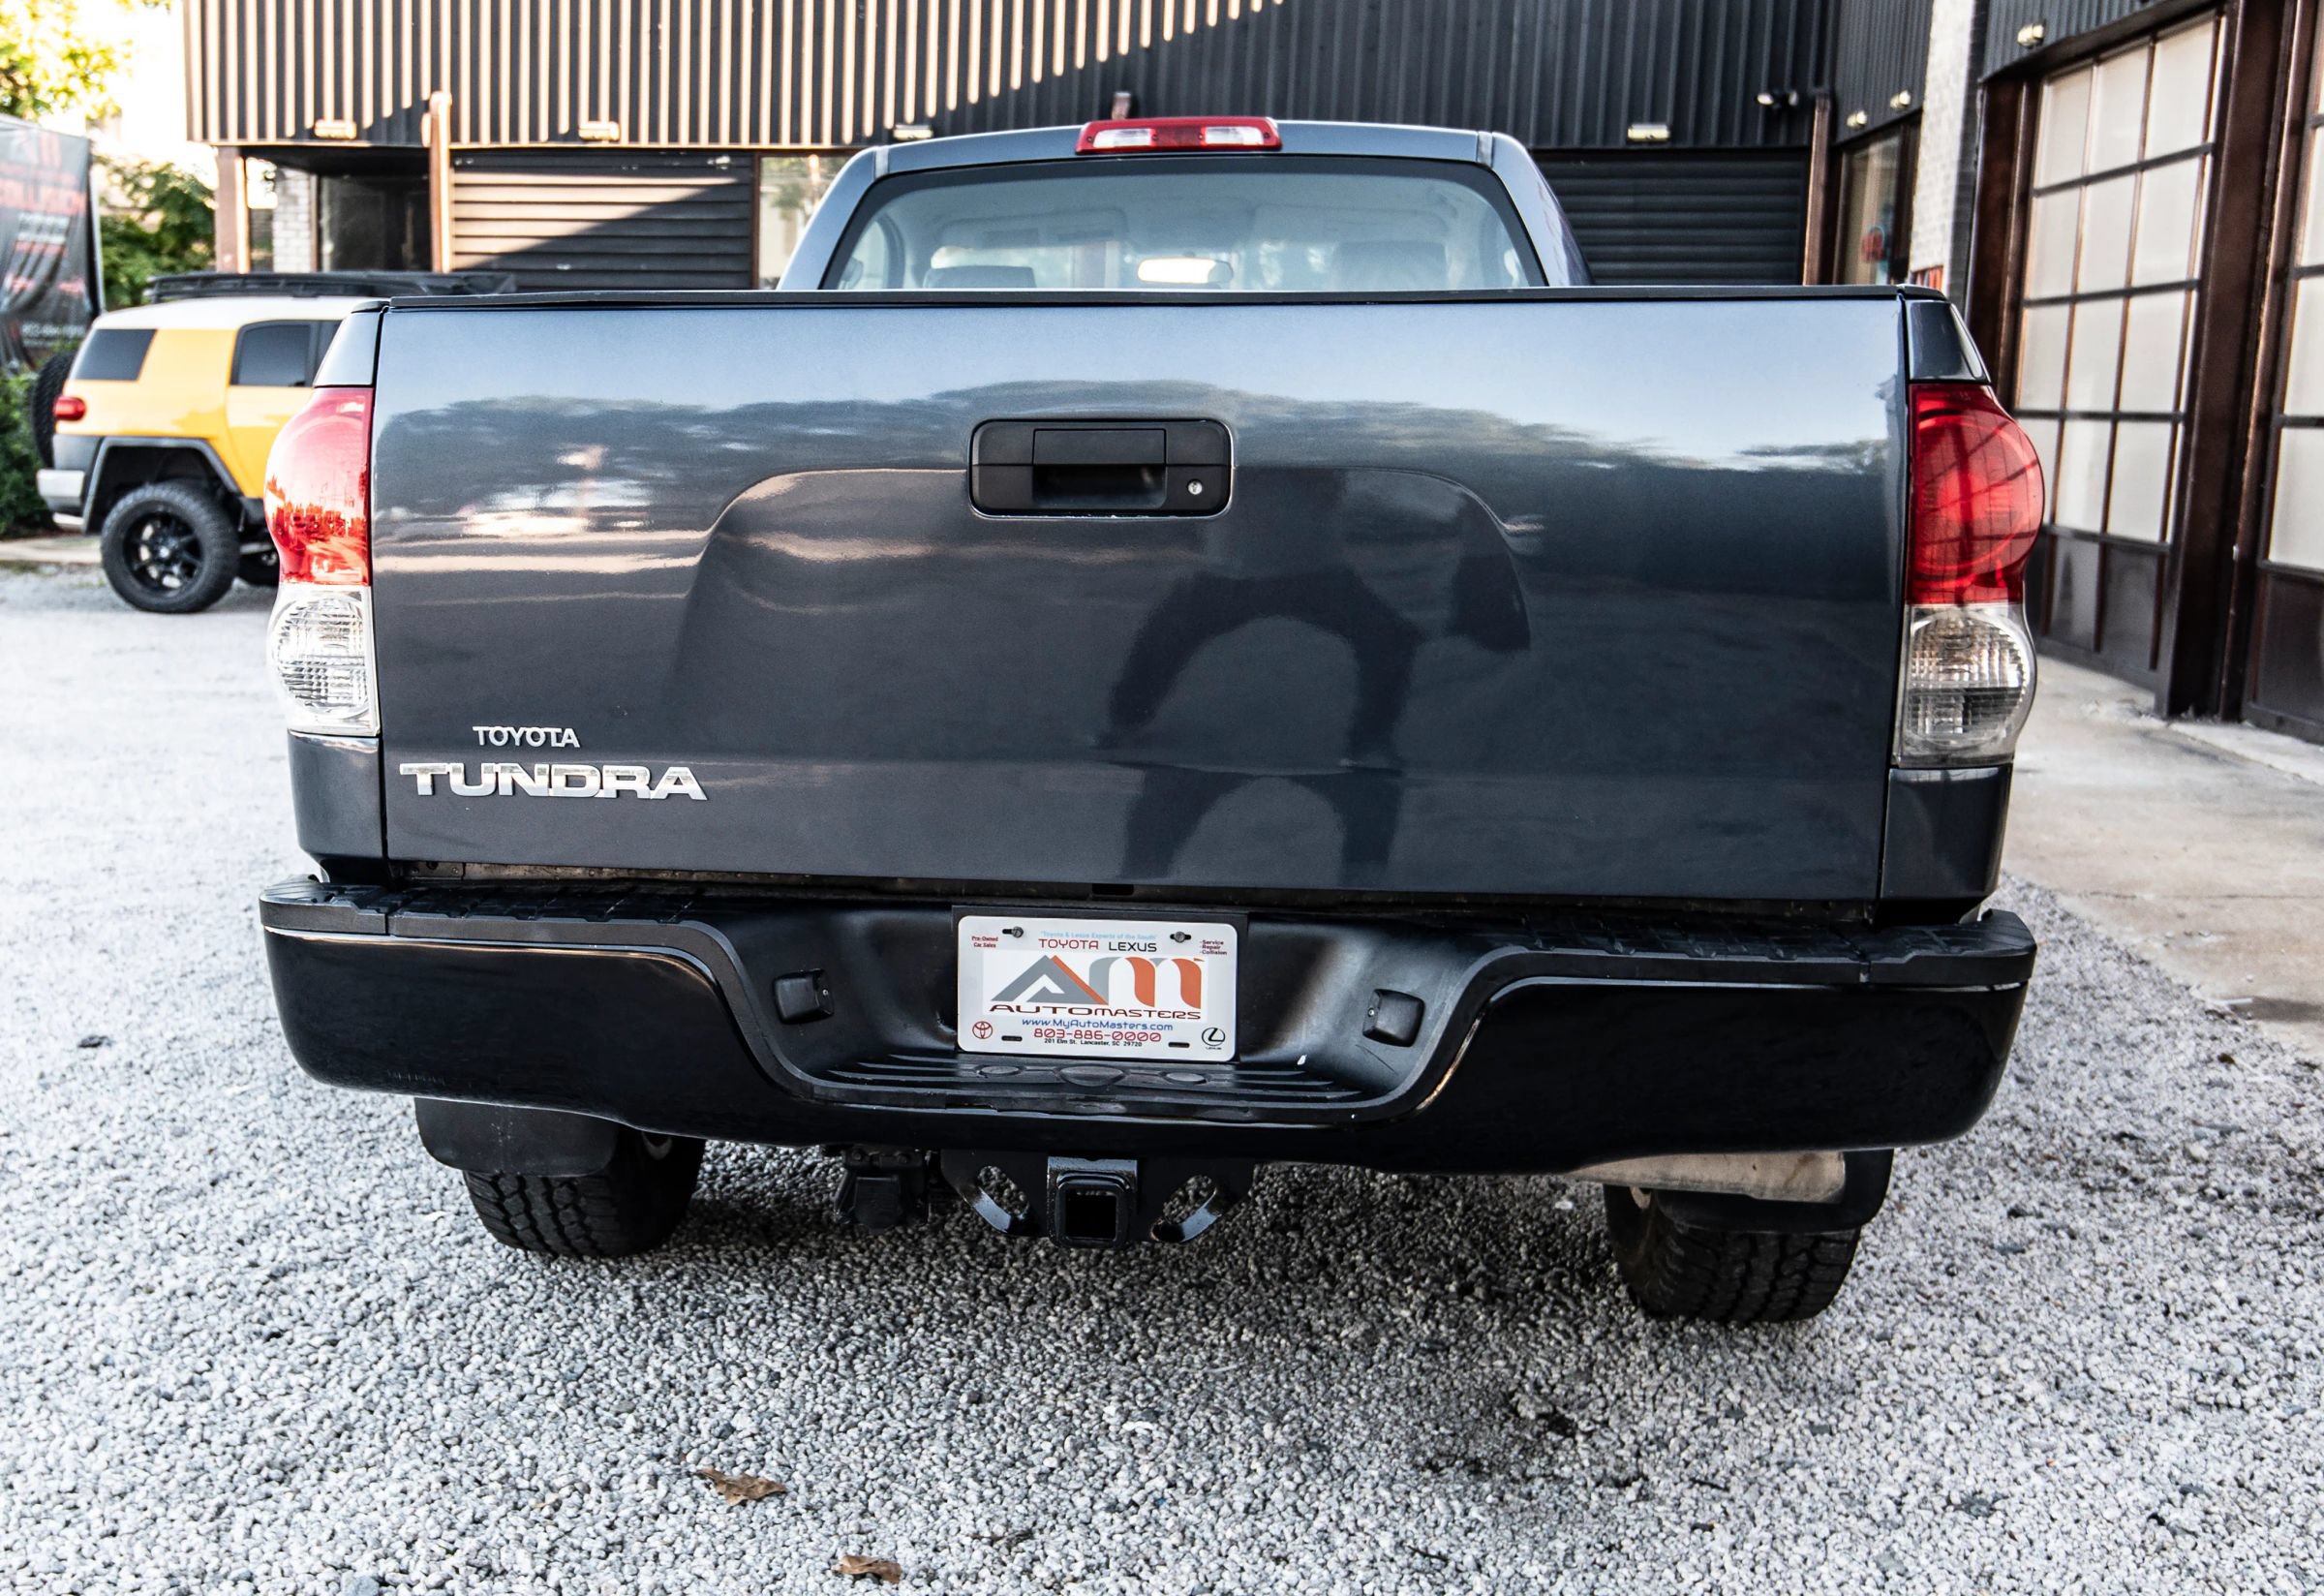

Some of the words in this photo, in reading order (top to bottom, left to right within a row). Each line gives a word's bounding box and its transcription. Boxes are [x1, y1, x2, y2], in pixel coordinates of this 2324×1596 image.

[473, 726, 580, 748] TOYOTA
[399, 762, 708, 801] TUNDRA
[1038, 938, 1099, 950] TOYOTA
[1109, 941, 1157, 952] LEXUS
[1022, 1018, 1174, 1031] www.MyAutoMasters.com
[1033, 1028, 1162, 1043] 803-886-0000
